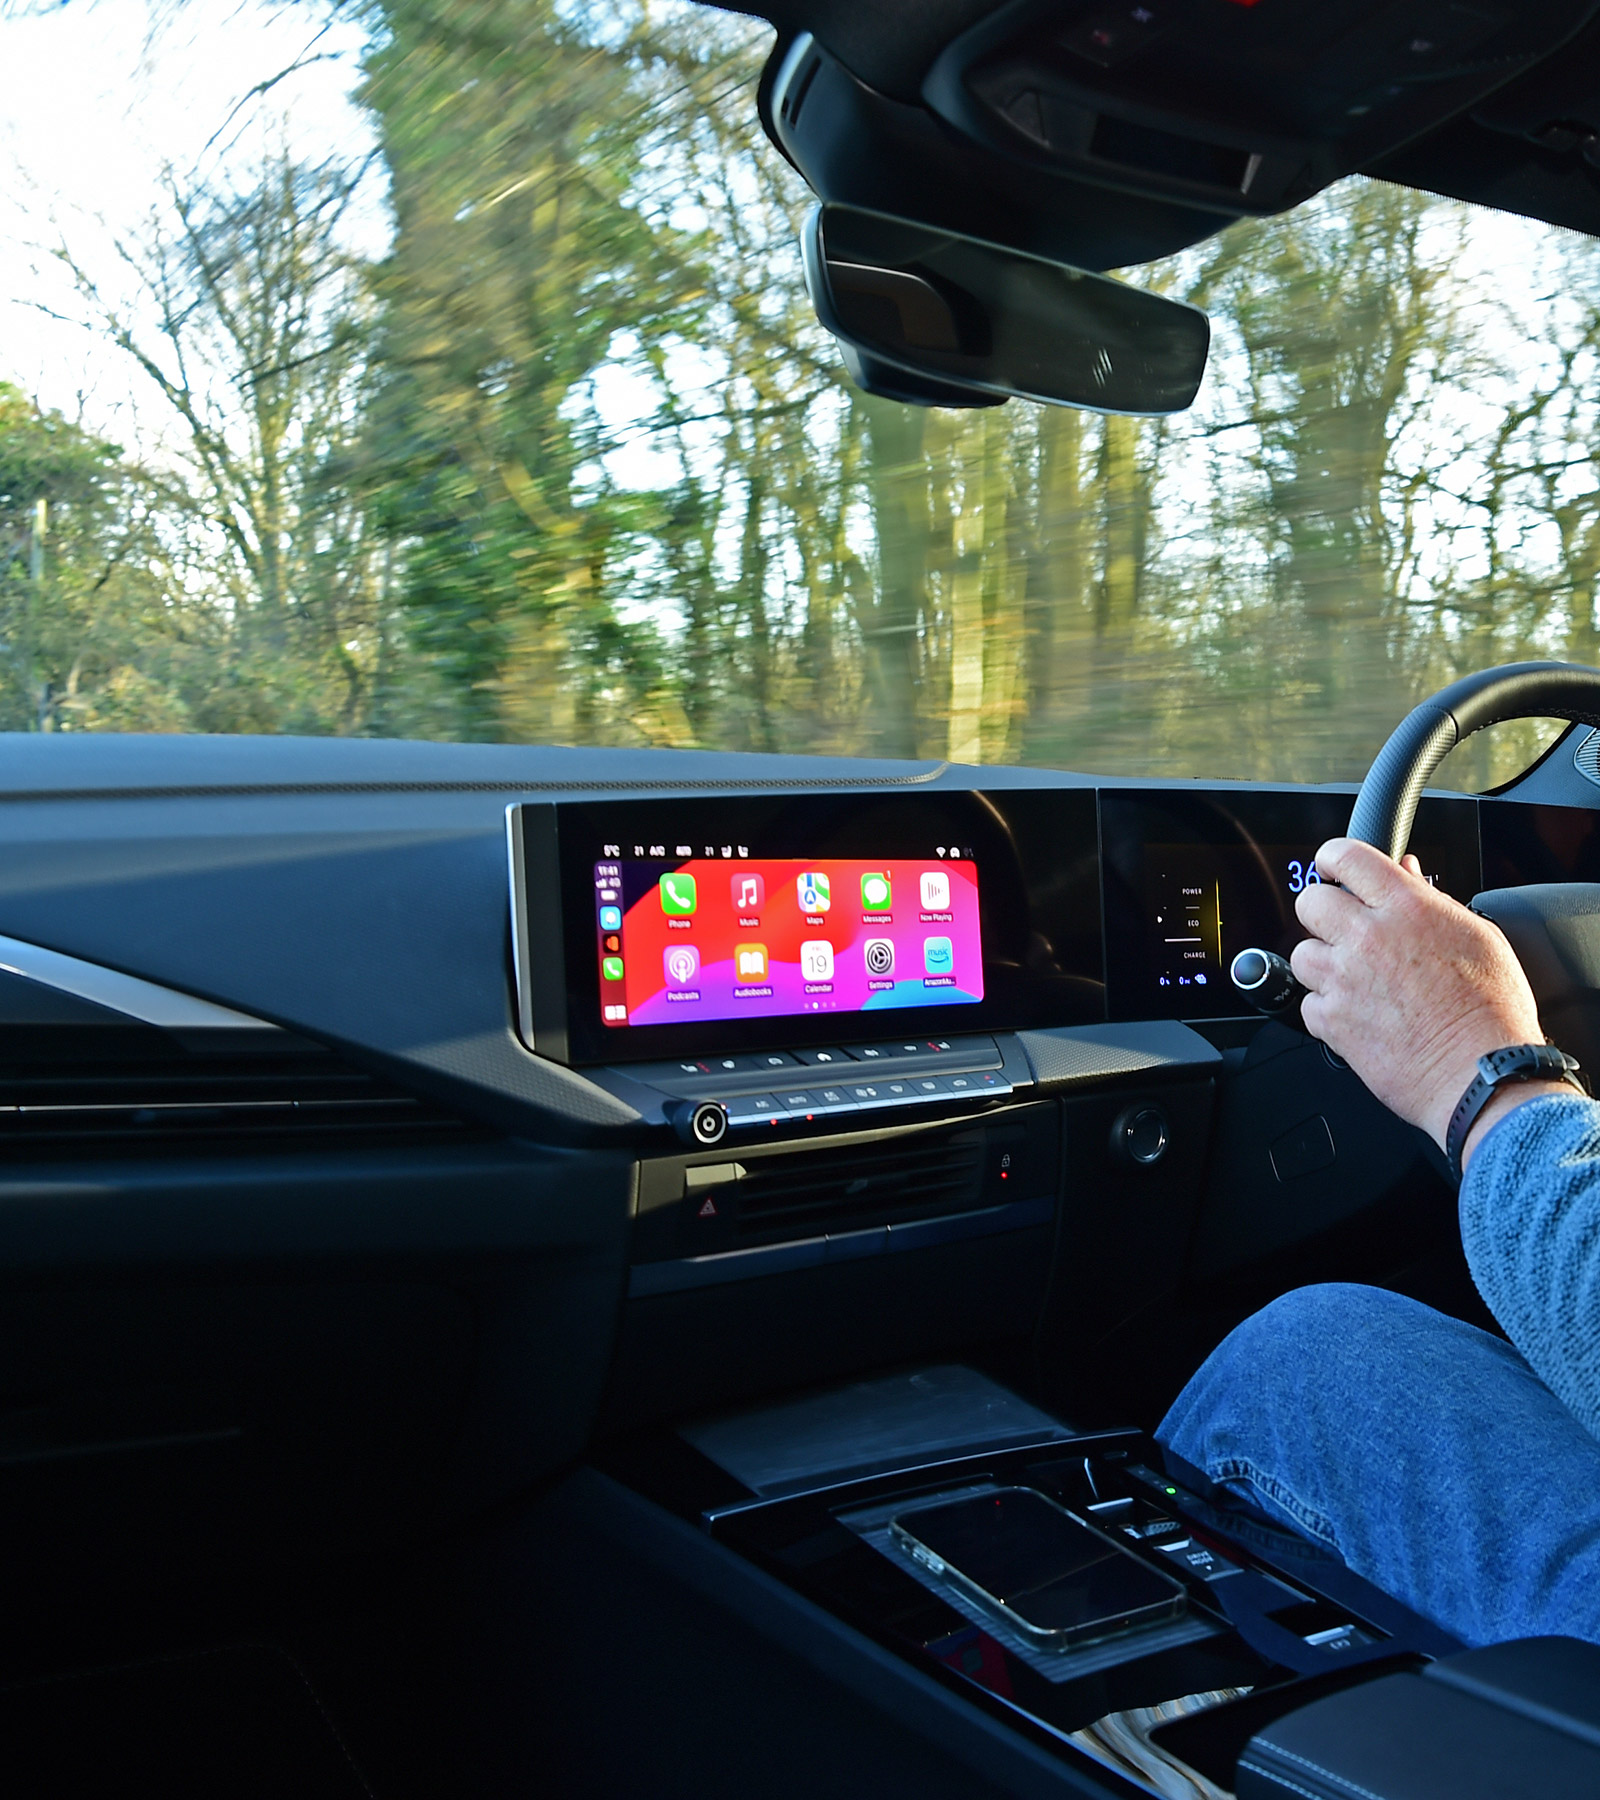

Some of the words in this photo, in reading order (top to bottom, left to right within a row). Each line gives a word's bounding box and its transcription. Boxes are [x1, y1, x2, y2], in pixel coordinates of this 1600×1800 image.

[1288, 860, 1321, 893] 36
[739, 917, 759, 926] Music
[806, 916, 824, 925] Maps
[862, 914, 892, 923] Messages
[920, 914, 932, 922] Now
[933, 913, 952, 922] Playing
[668, 919, 691, 928] Phone
[927, 948, 948, 956] music
[1183, 951, 1206, 959] CHARGE
[808, 955, 827, 973] 19
[805, 984, 832, 993] Calendar
[869, 981, 893, 990] Settings
[667, 991, 699, 1001] Podcasts
[734, 987, 772, 997] Audiobooks
